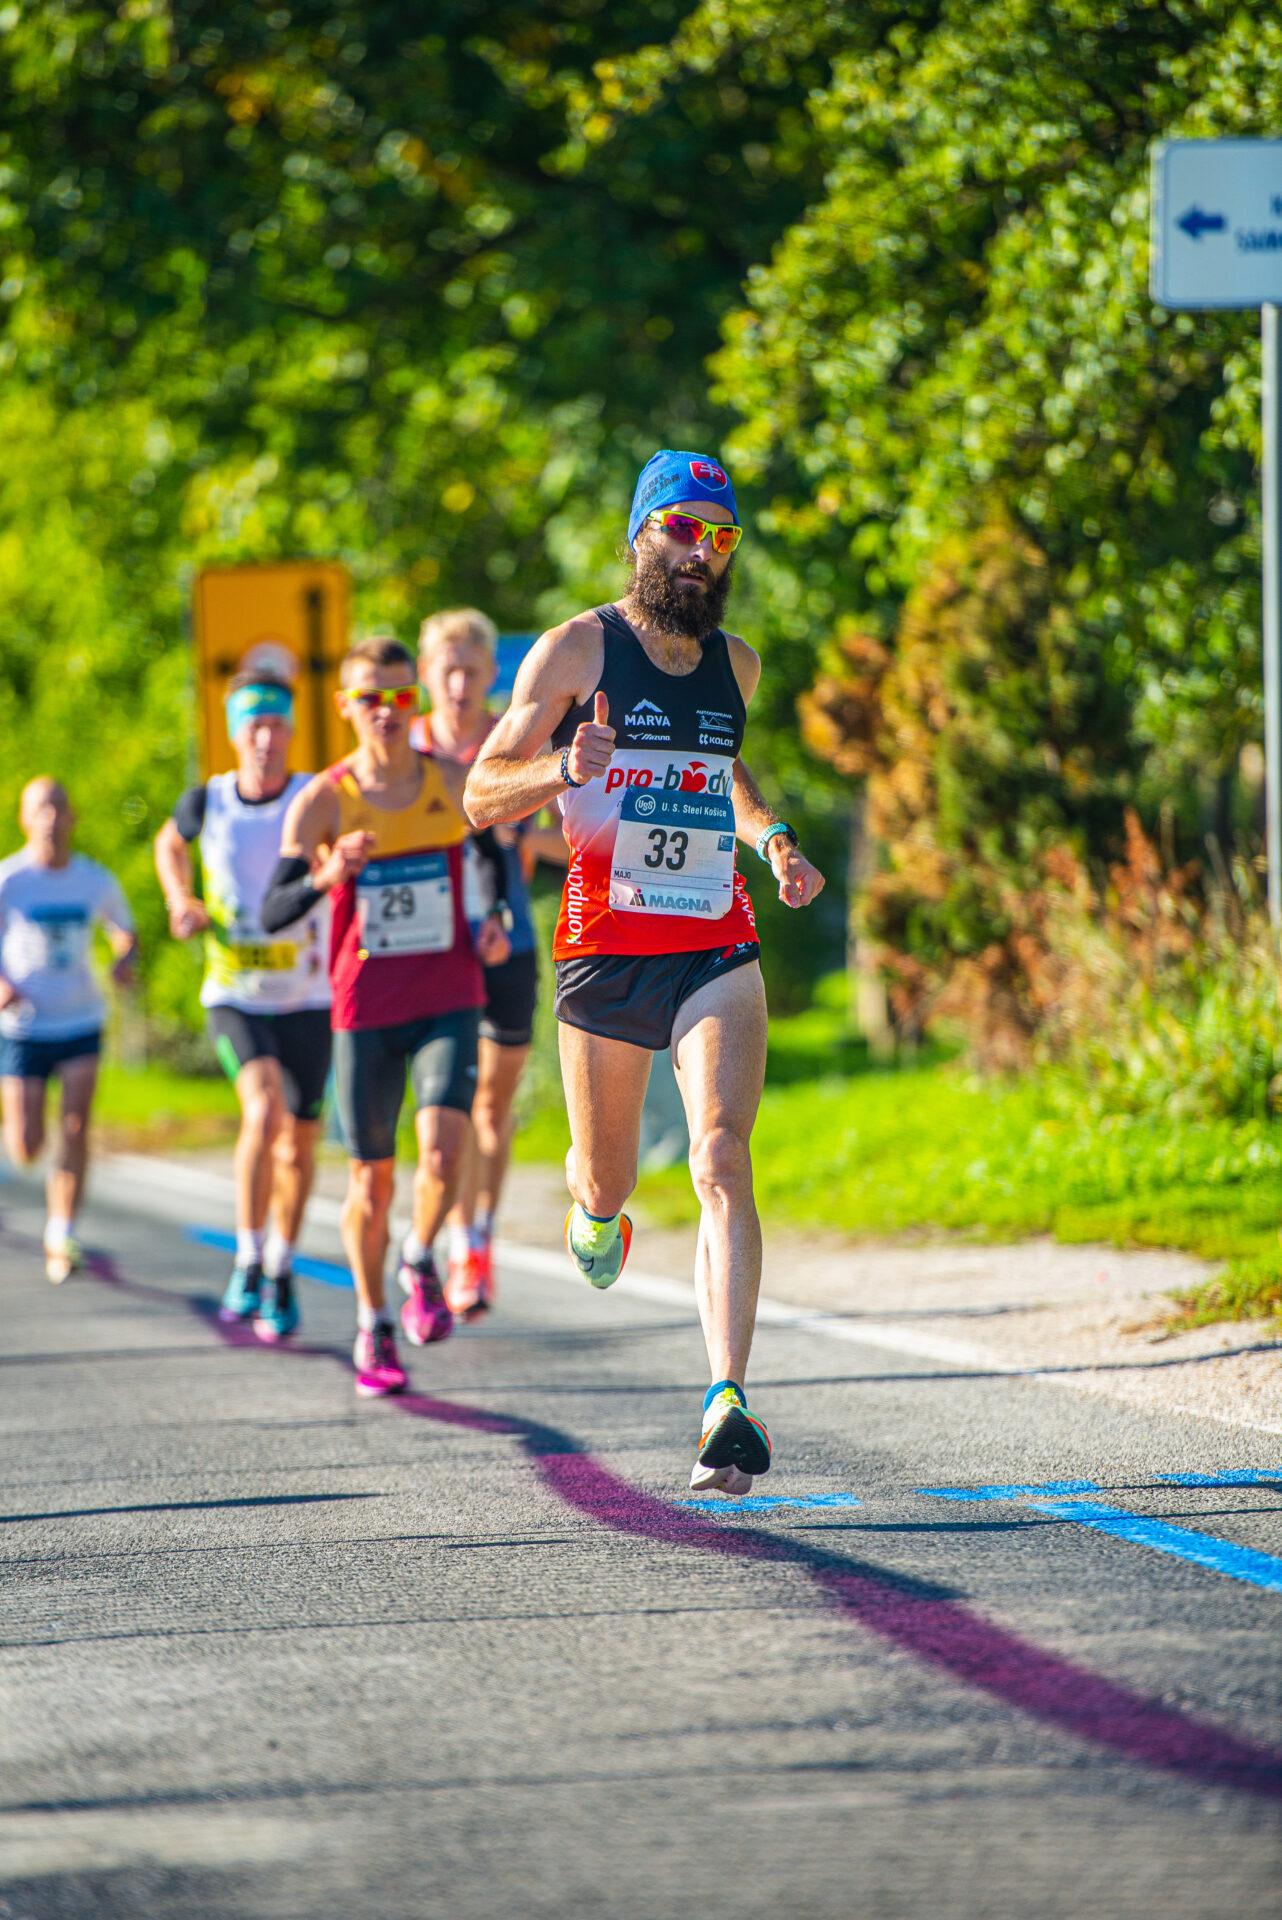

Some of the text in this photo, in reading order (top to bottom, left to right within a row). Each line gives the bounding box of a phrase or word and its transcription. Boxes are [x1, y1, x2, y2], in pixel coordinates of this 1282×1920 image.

[624, 714, 671, 727] MARVA
[682, 805, 702, 814] Steel
[704, 807, 727, 818] Košice
[644, 828, 689, 871] 33
[381, 886, 415, 920] 29
[648, 894, 712, 913] MAGNA
